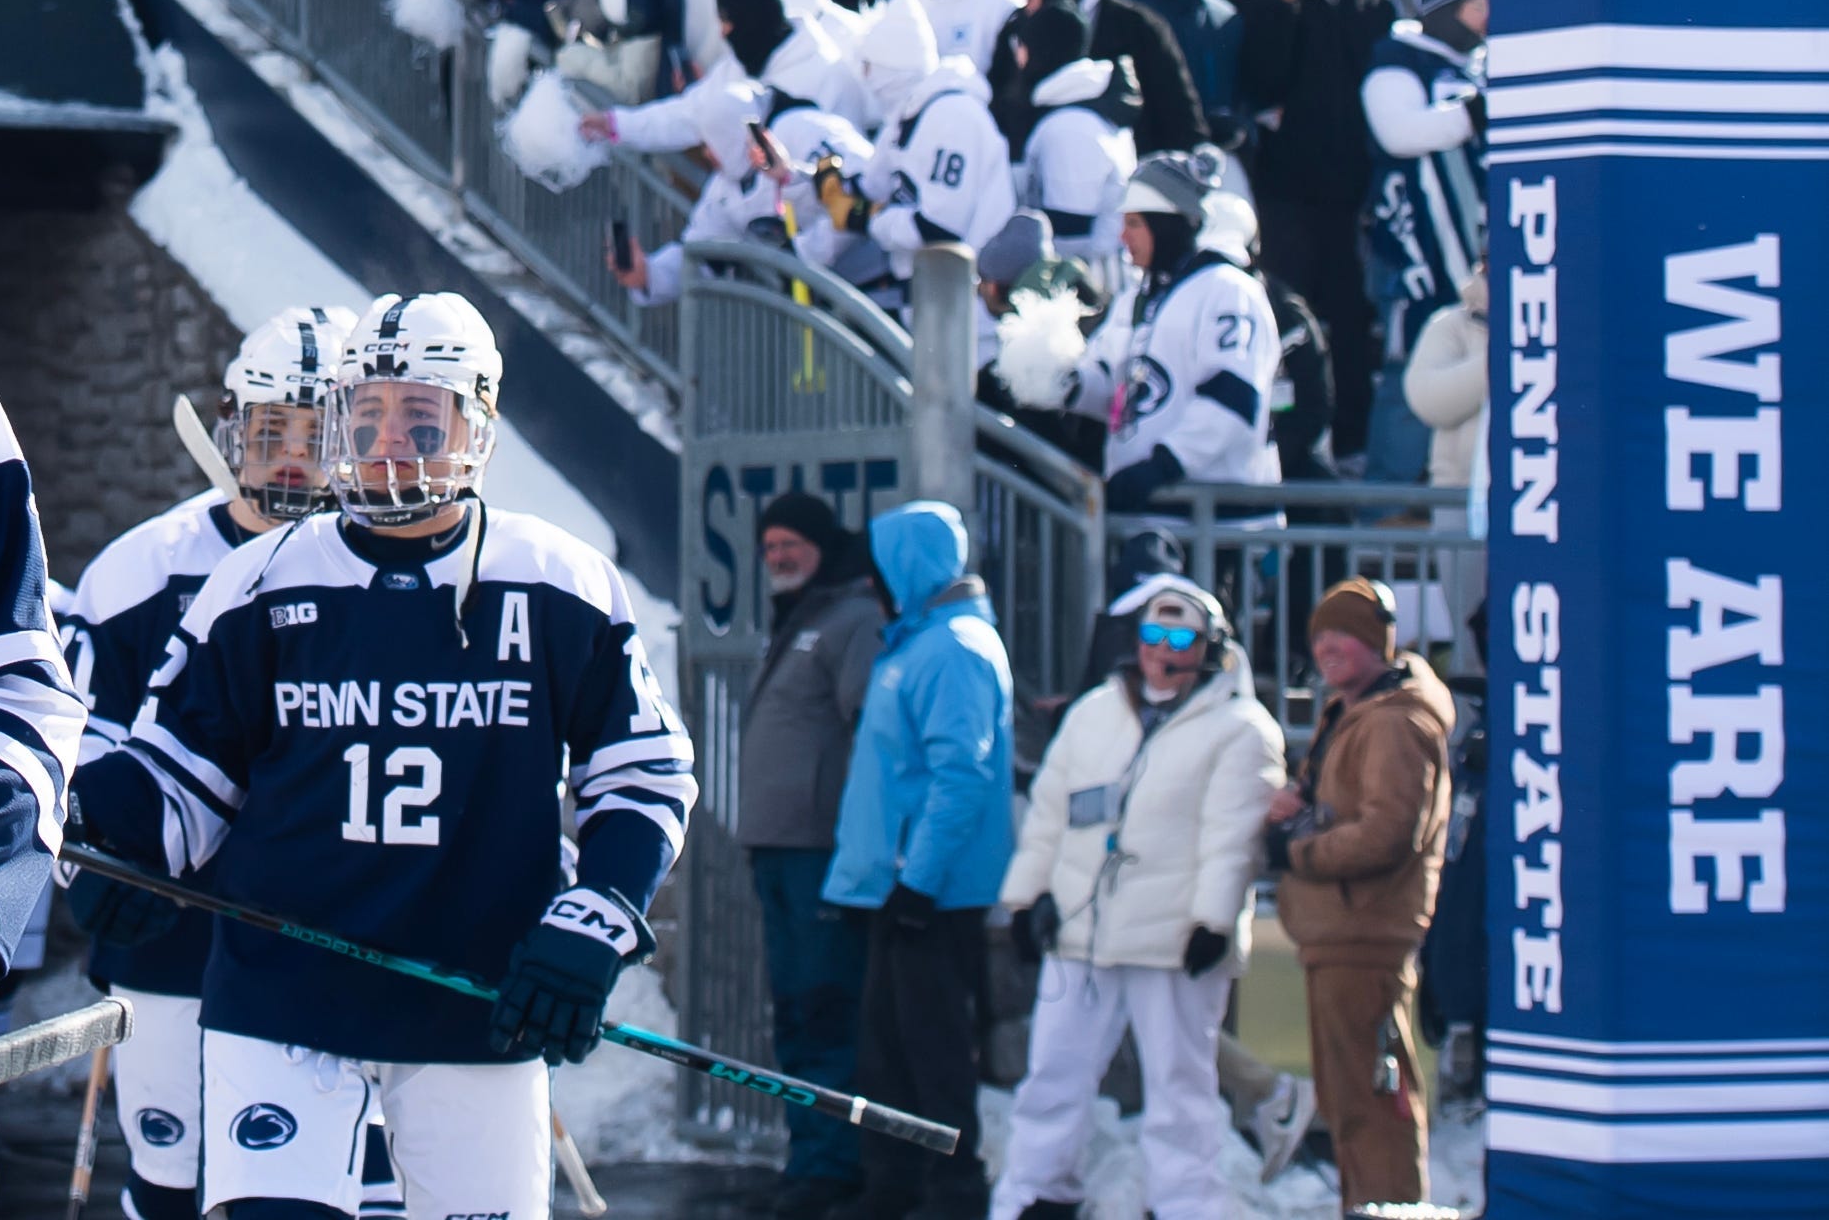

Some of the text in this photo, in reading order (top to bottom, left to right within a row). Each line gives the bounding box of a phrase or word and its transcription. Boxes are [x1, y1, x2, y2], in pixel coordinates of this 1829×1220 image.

[930, 148, 964, 188] 18
[364, 341, 411, 354] CCM
[1509, 176, 1562, 1013] PENN STATE
[1664, 233, 1786, 914] WE ARE
[497, 591, 532, 663] A
[275, 680, 532, 729] PENN STATE
[341, 742, 443, 847] 12
[548, 899, 627, 943] CM
[708, 1061, 818, 1108] CCM
